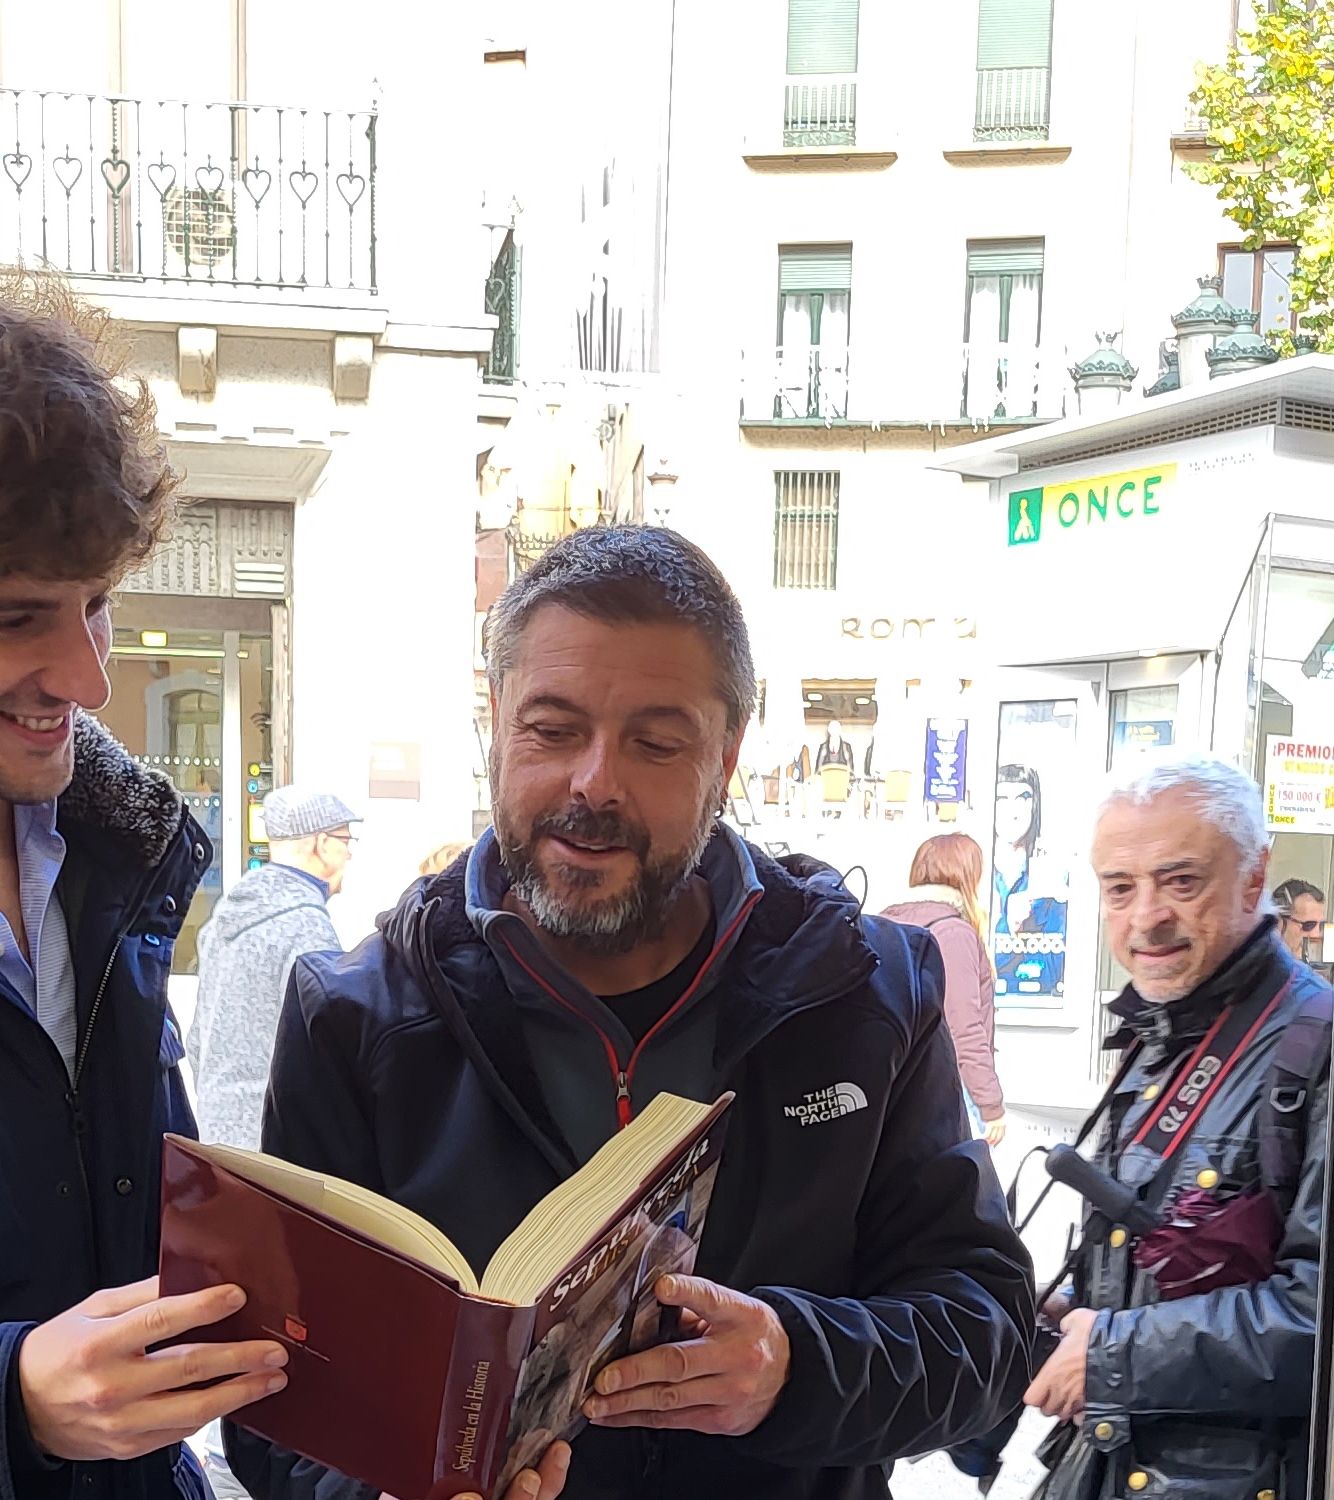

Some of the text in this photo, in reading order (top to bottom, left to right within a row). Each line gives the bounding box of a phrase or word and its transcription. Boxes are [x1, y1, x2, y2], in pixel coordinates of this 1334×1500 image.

[1058, 476, 1162, 528] ONCE
[803, 1086, 836, 1103] THE
[1176, 1055, 1222, 1106] EOS
[783, 1096, 839, 1117] NORTH
[800, 1106, 841, 1127] FACE
[452, 1361, 490, 1473] Sepúlveda en la Historia
